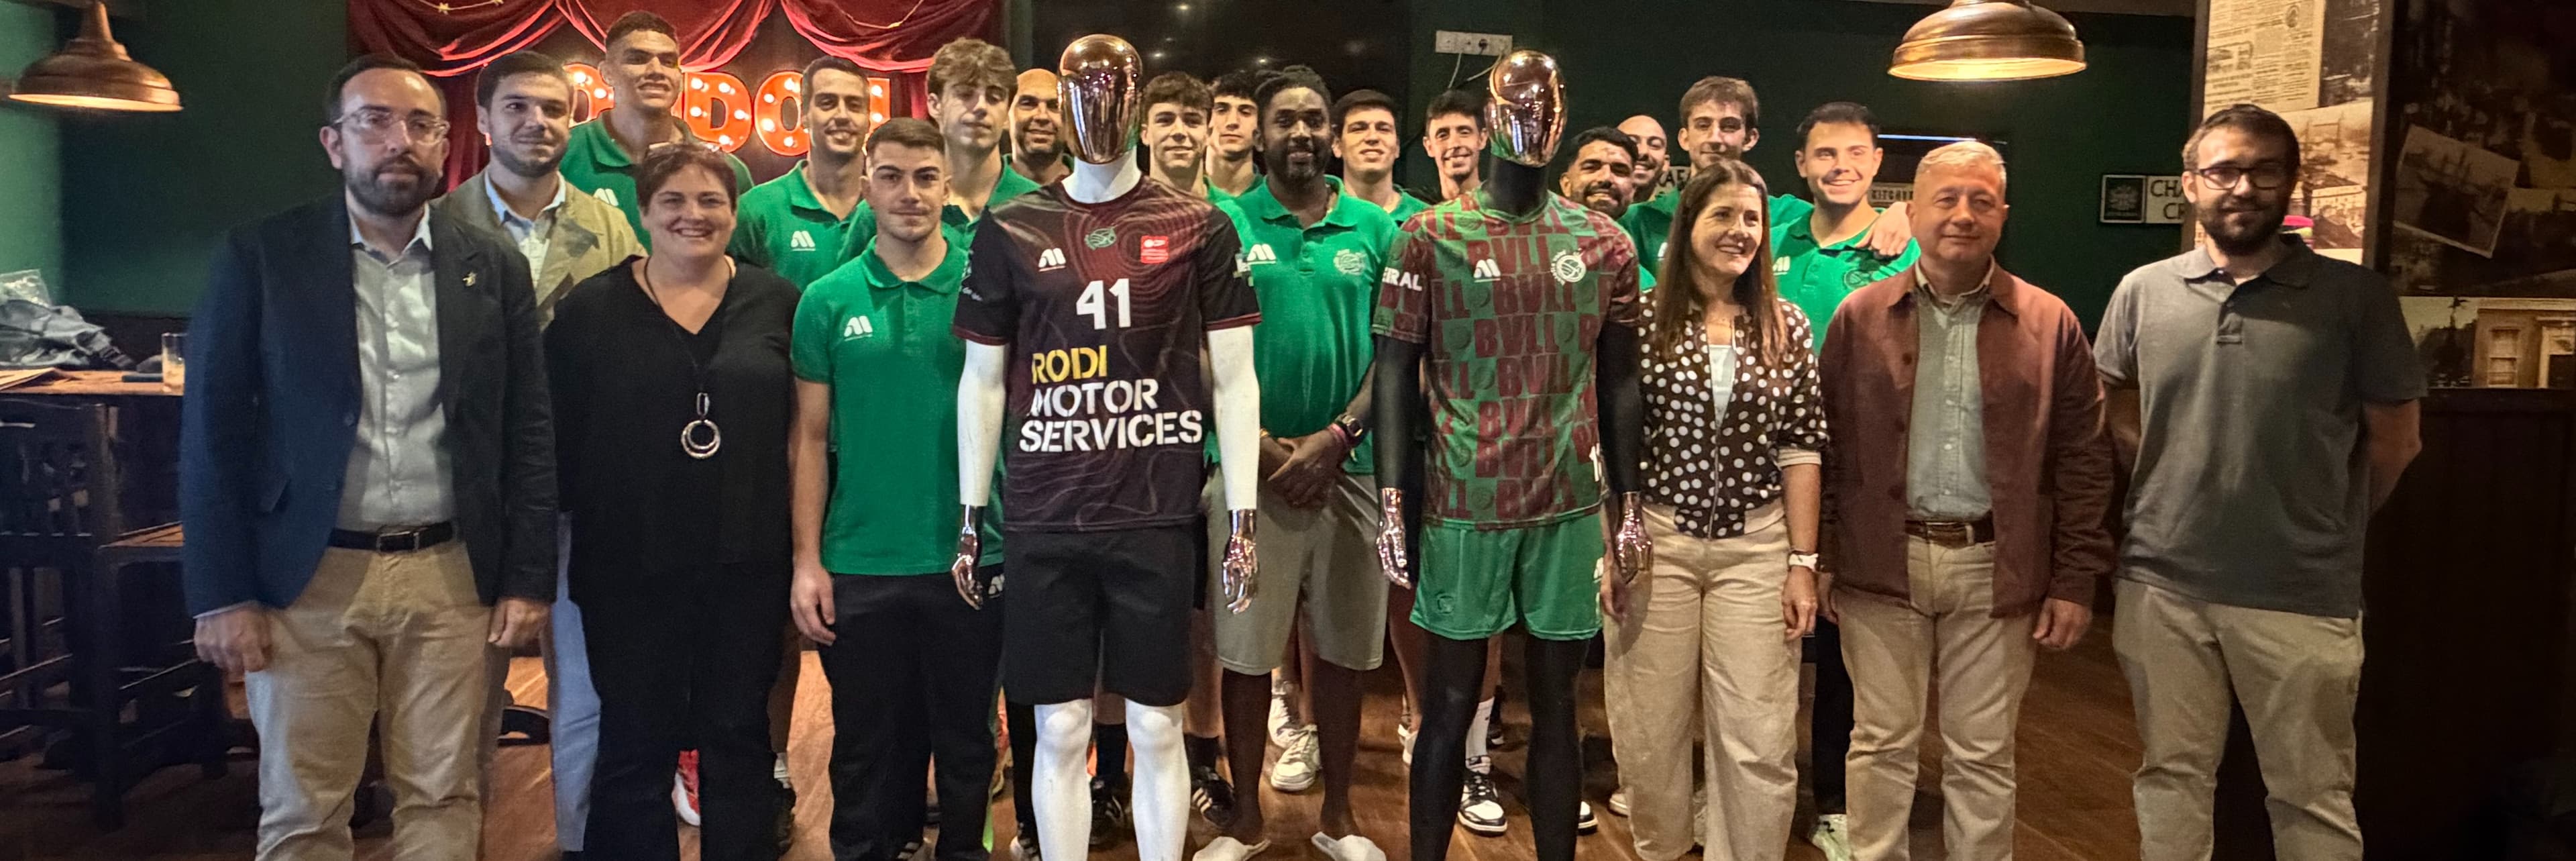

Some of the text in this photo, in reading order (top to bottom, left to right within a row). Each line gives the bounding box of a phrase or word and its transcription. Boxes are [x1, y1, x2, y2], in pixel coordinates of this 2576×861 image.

[2150, 179, 2185, 197] CH
[1076, 278, 1131, 330] 41
[1032, 345, 1107, 384] RODI
[1027, 378, 1159, 417] MOTOR
[1019, 410, 1203, 452] SERVICES
